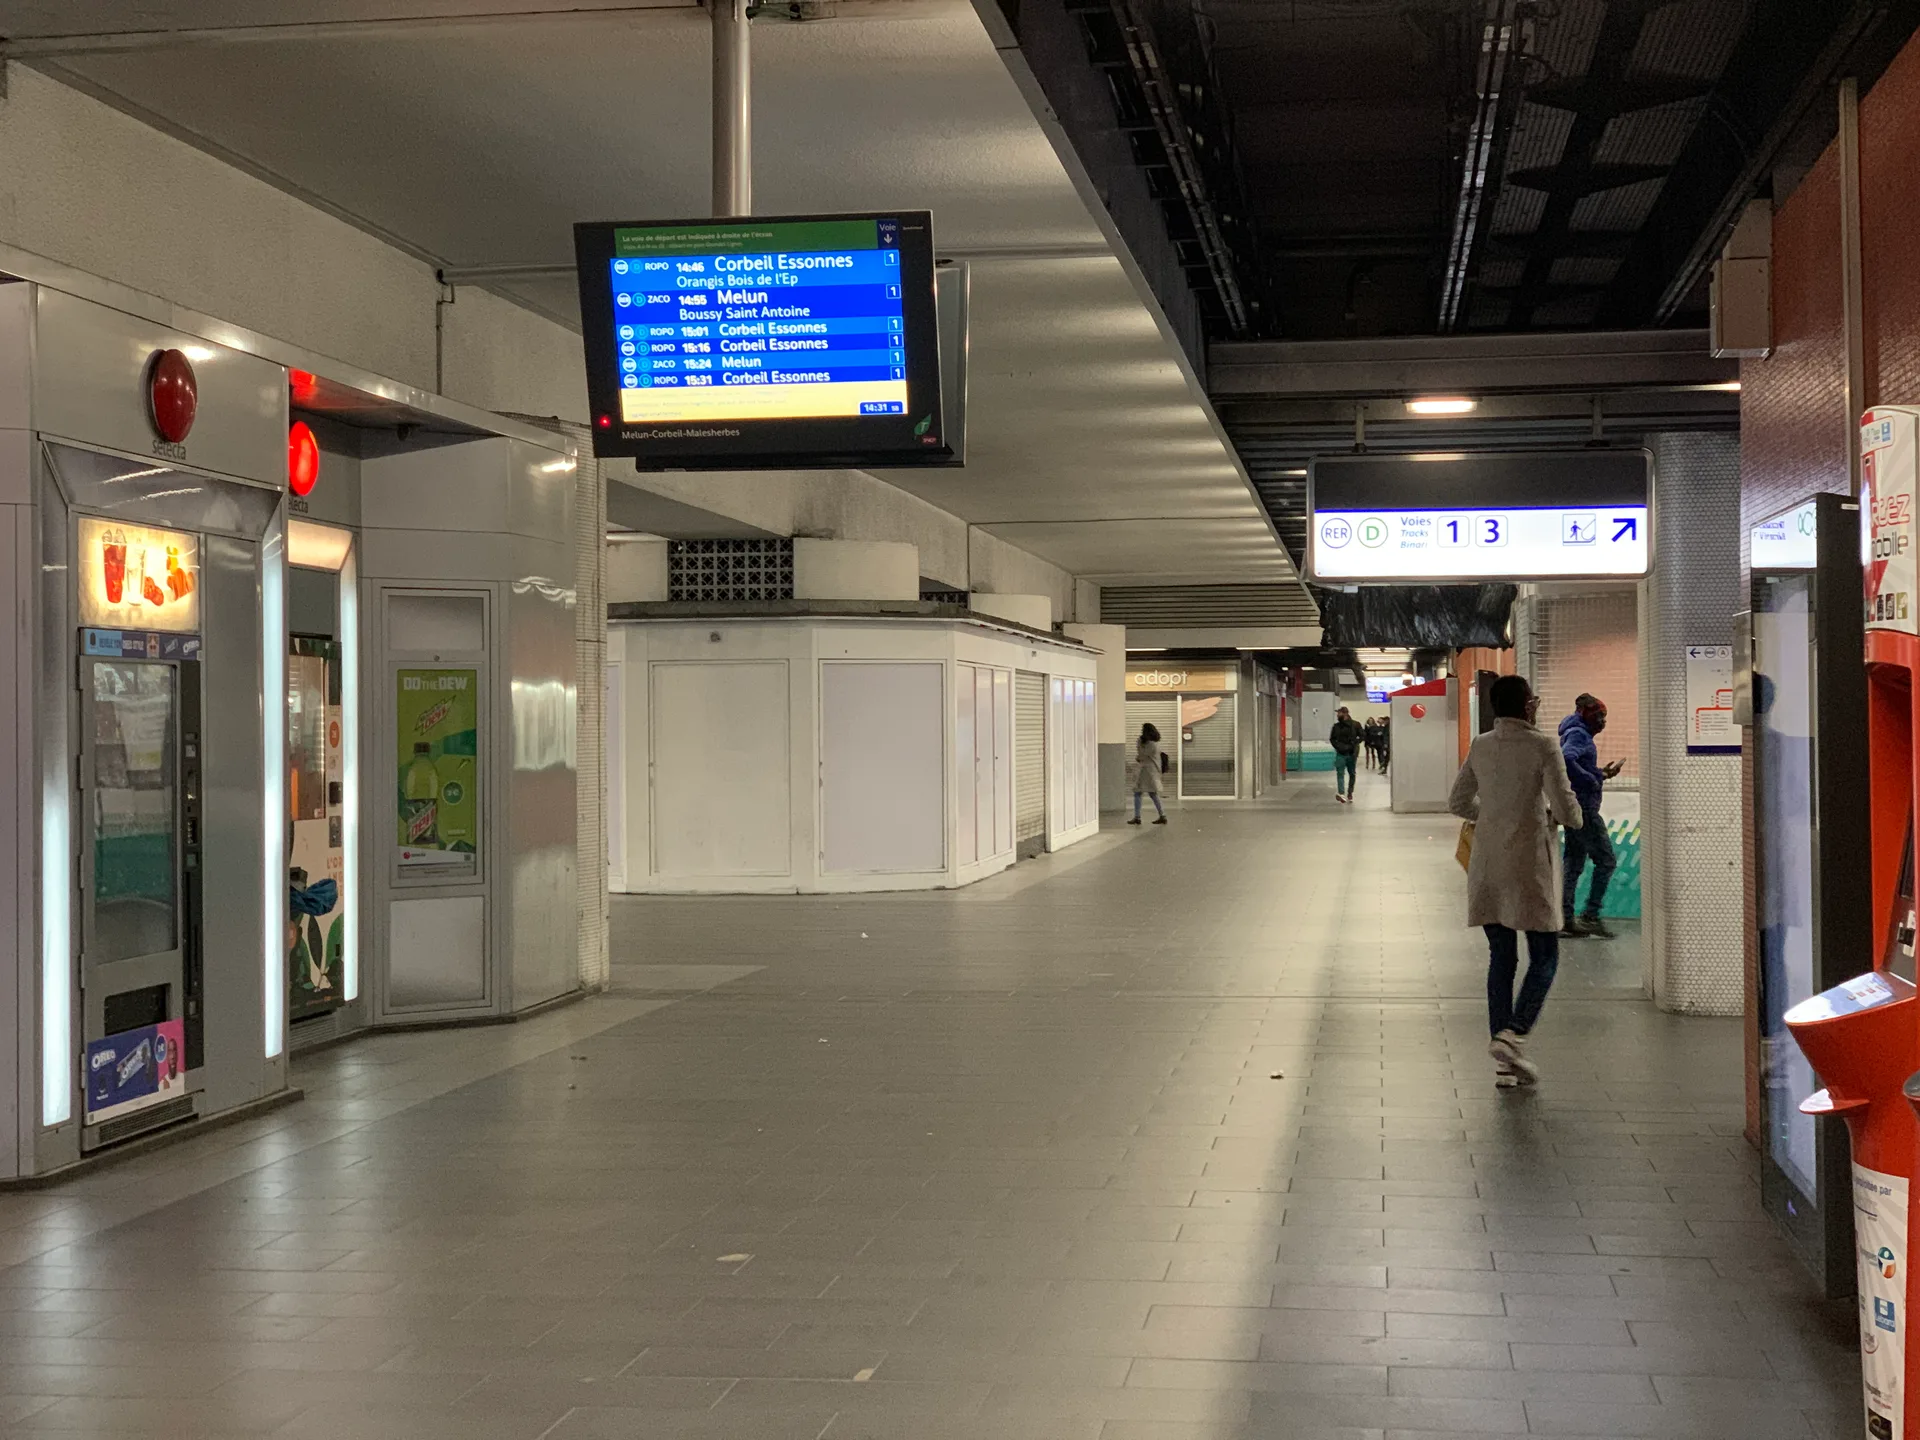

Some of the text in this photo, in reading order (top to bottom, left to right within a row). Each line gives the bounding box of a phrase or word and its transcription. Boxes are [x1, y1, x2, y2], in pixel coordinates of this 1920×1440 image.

[879, 223, 897, 232] Voie
[644, 262, 670, 271] ROPO
[676, 262, 705, 273] 14:46
[714, 255, 774, 272] Corbeil
[777, 254, 854, 270] Essonnes
[888, 253, 895, 264] 1
[676, 272, 799, 290] Orangis Bois de l'Ep
[647, 294, 671, 304] ZACO
[678, 294, 708, 306] 14:55
[717, 288, 768, 305] Melun
[890, 286, 897, 297] 1
[679, 304, 811, 322] Boussy Saint Antoine
[650, 328, 674, 336] ROPO
[680, 326, 709, 338] 15:01
[719, 323, 766, 336] Corbeil
[768, 322, 828, 335] Essonnes
[892, 318, 898, 330] 1
[651, 344, 676, 352] ROPO
[682, 342, 711, 354] 15:16
[720, 338, 767, 352] Corbeil
[769, 338, 829, 351] Essonnes
[893, 335, 899, 346] 1
[652, 360, 676, 369] ZACO
[683, 358, 712, 370] 15:24
[722, 356, 762, 368] Melun
[894, 352, 900, 362] 1
[654, 376, 679, 385] ROPO
[684, 374, 713, 386] 15:31
[722, 372, 769, 385] Corbeil
[771, 371, 830, 384] Essonnes
[895, 368, 901, 378] 1
[863, 403, 888, 412] 14:31
[621, 428, 741, 440] Melun-Corbeil-Malesherbes
[288, 498, 309, 514] electa
[1400, 516, 1432, 526] Voies
[1325, 519, 1500, 543] RER D 1 3
[1400, 529, 1429, 538] Tracks
[1400, 540, 1428, 549] Binari
[403, 677, 421, 690] DO
[439, 676, 468, 690] DEW
[1134, 669, 1188, 689] adopt
[91, 1049, 116, 1069] OREO
[1880, 1186, 1892, 1196] par
